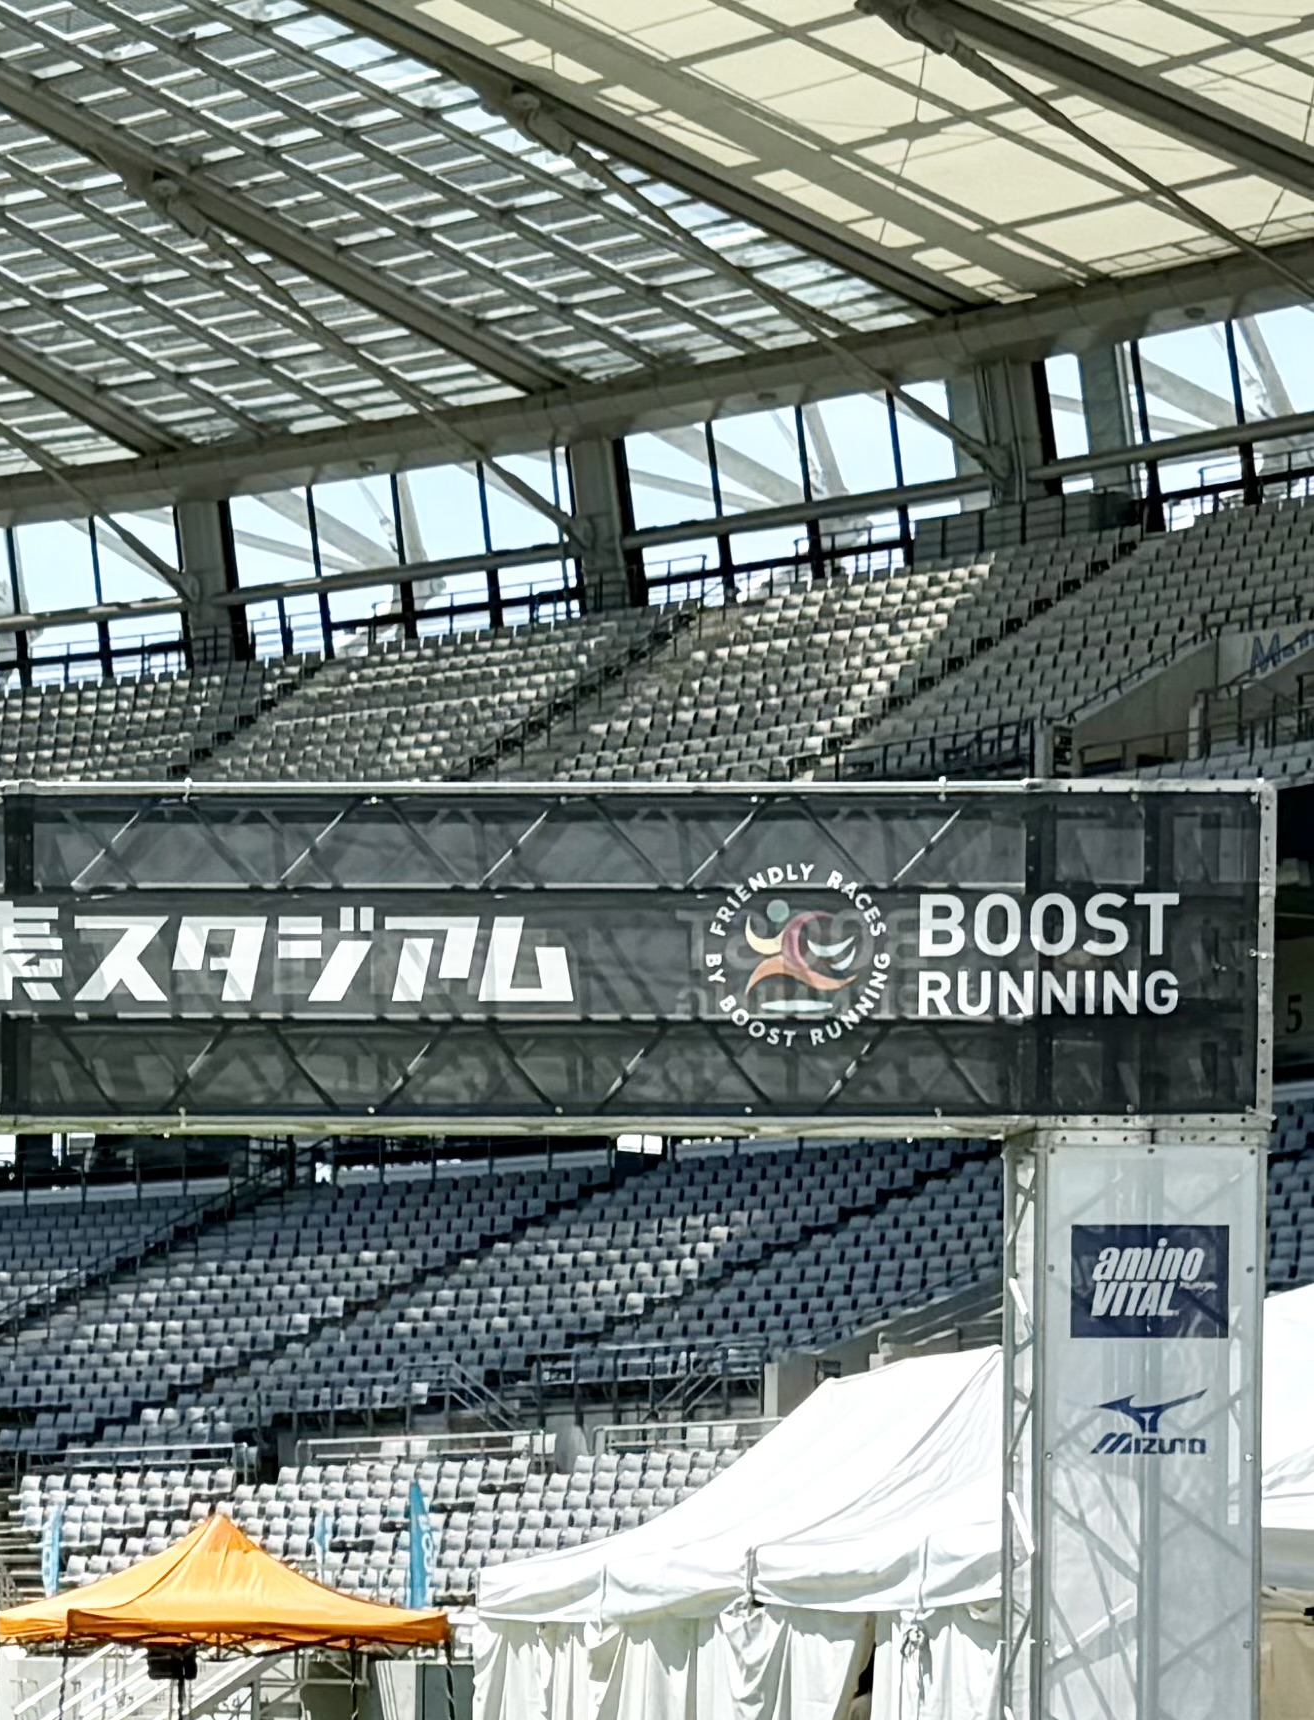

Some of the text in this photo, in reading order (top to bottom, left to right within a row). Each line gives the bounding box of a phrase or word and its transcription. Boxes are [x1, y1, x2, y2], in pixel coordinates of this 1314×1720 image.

[709, 863, 887, 938] FRIENDLY RACES
[918, 892, 1180, 958] BOOST
[704, 952, 891, 1047] BY BOOST RUNNING
[917, 969, 1180, 1017] RUNNING
[1285, 994, 1303, 1034] 5
[1091, 1237, 1205, 1282] amino
[1090, 1281, 1179, 1317] VITAL
